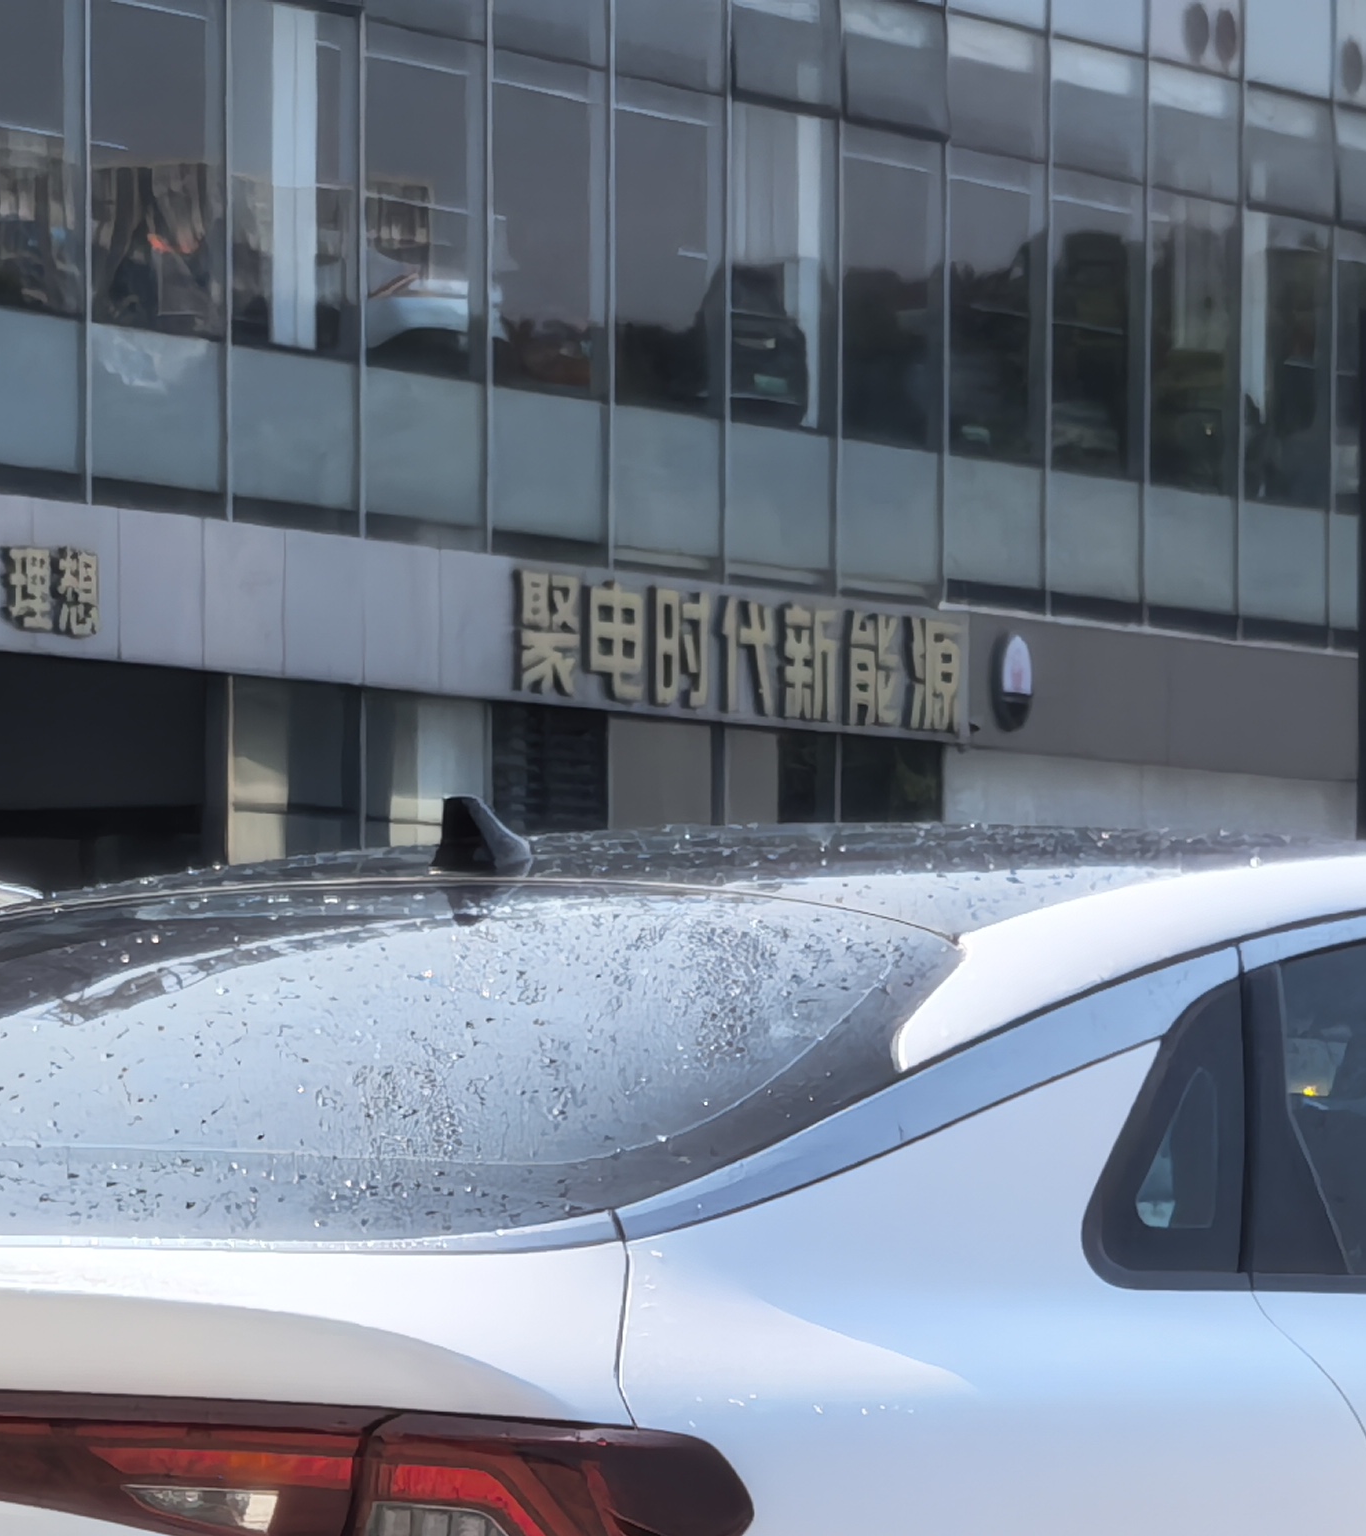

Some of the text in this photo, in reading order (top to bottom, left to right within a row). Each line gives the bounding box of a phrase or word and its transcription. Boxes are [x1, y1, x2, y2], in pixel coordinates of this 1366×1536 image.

[7, 546, 100, 638] 理想
[517, 568, 961, 733] 聚电时代新能源
